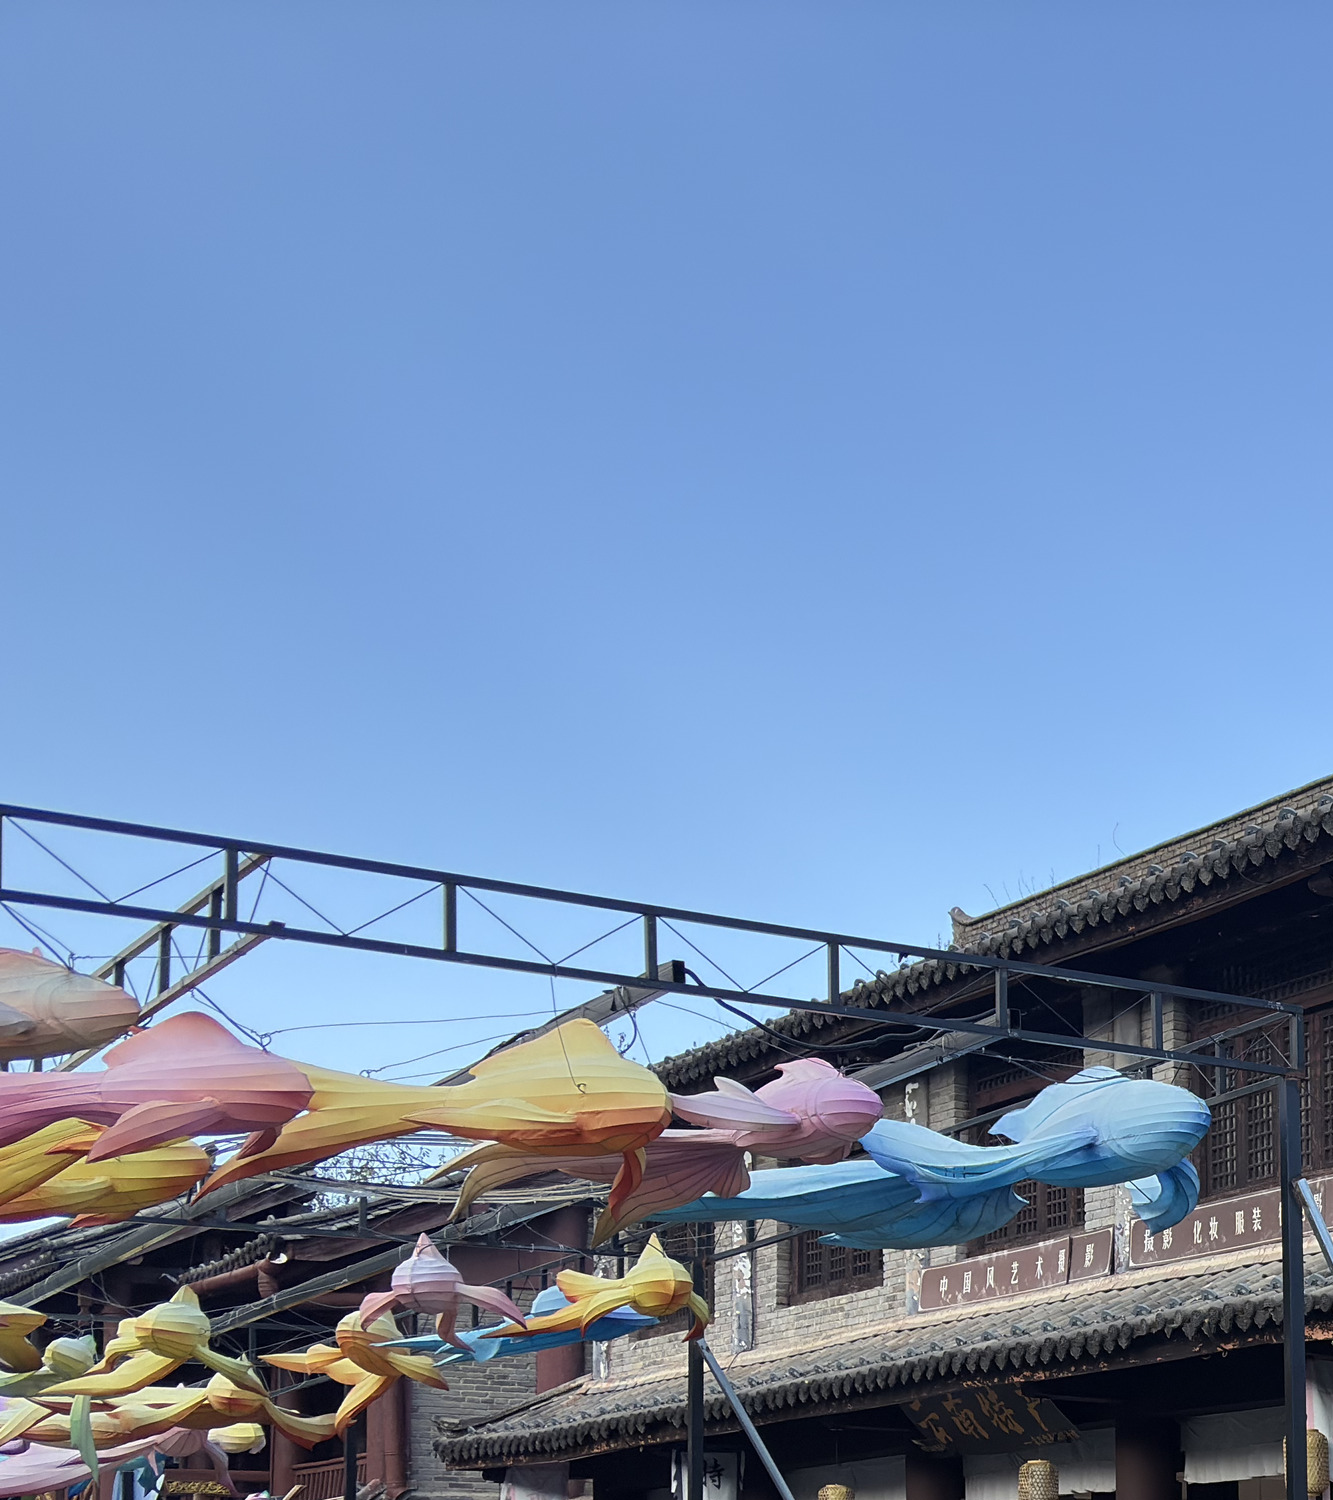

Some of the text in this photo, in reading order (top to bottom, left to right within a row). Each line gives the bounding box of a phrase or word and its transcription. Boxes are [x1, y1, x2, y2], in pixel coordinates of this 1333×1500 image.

[1193, 1215, 1219, 1245] 化妆
[1235, 1206, 1263, 1237] 服装
[939, 1243, 1095, 1299] 中国风艺术摄影
